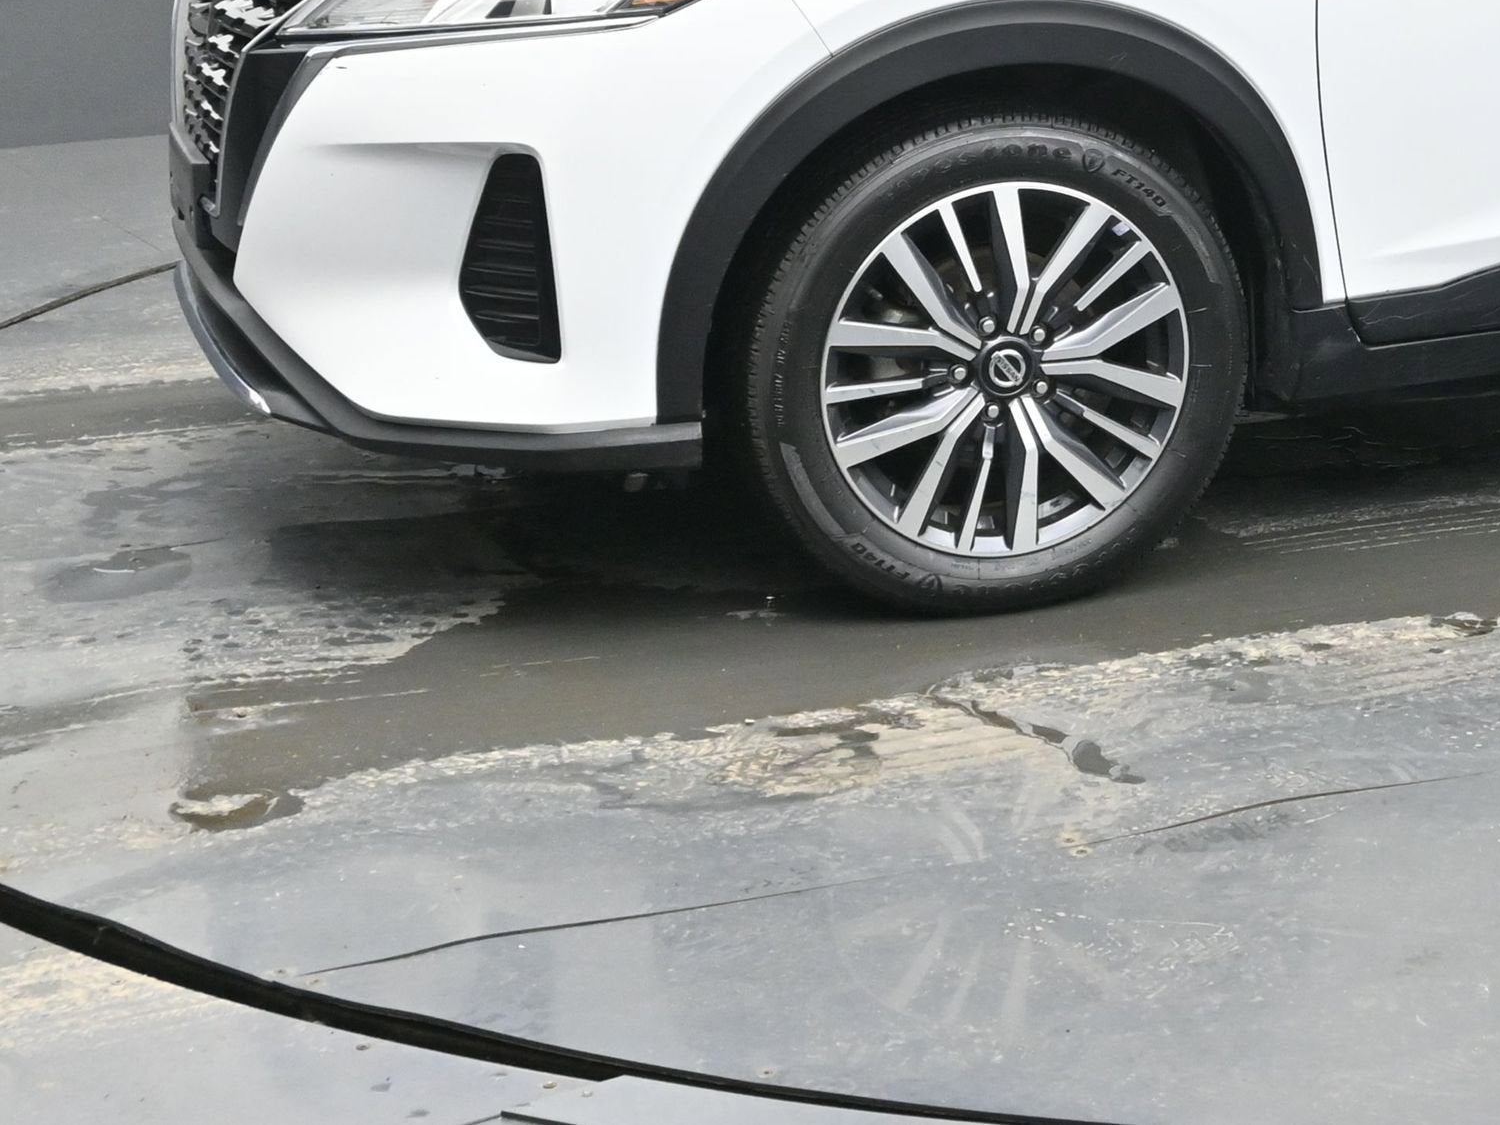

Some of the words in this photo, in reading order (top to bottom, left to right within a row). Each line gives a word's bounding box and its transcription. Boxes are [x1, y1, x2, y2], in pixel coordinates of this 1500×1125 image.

[883, 142, 1074, 203] restone
[1111, 168, 1168, 208] FT140
[850, 541, 911, 581] FT140
